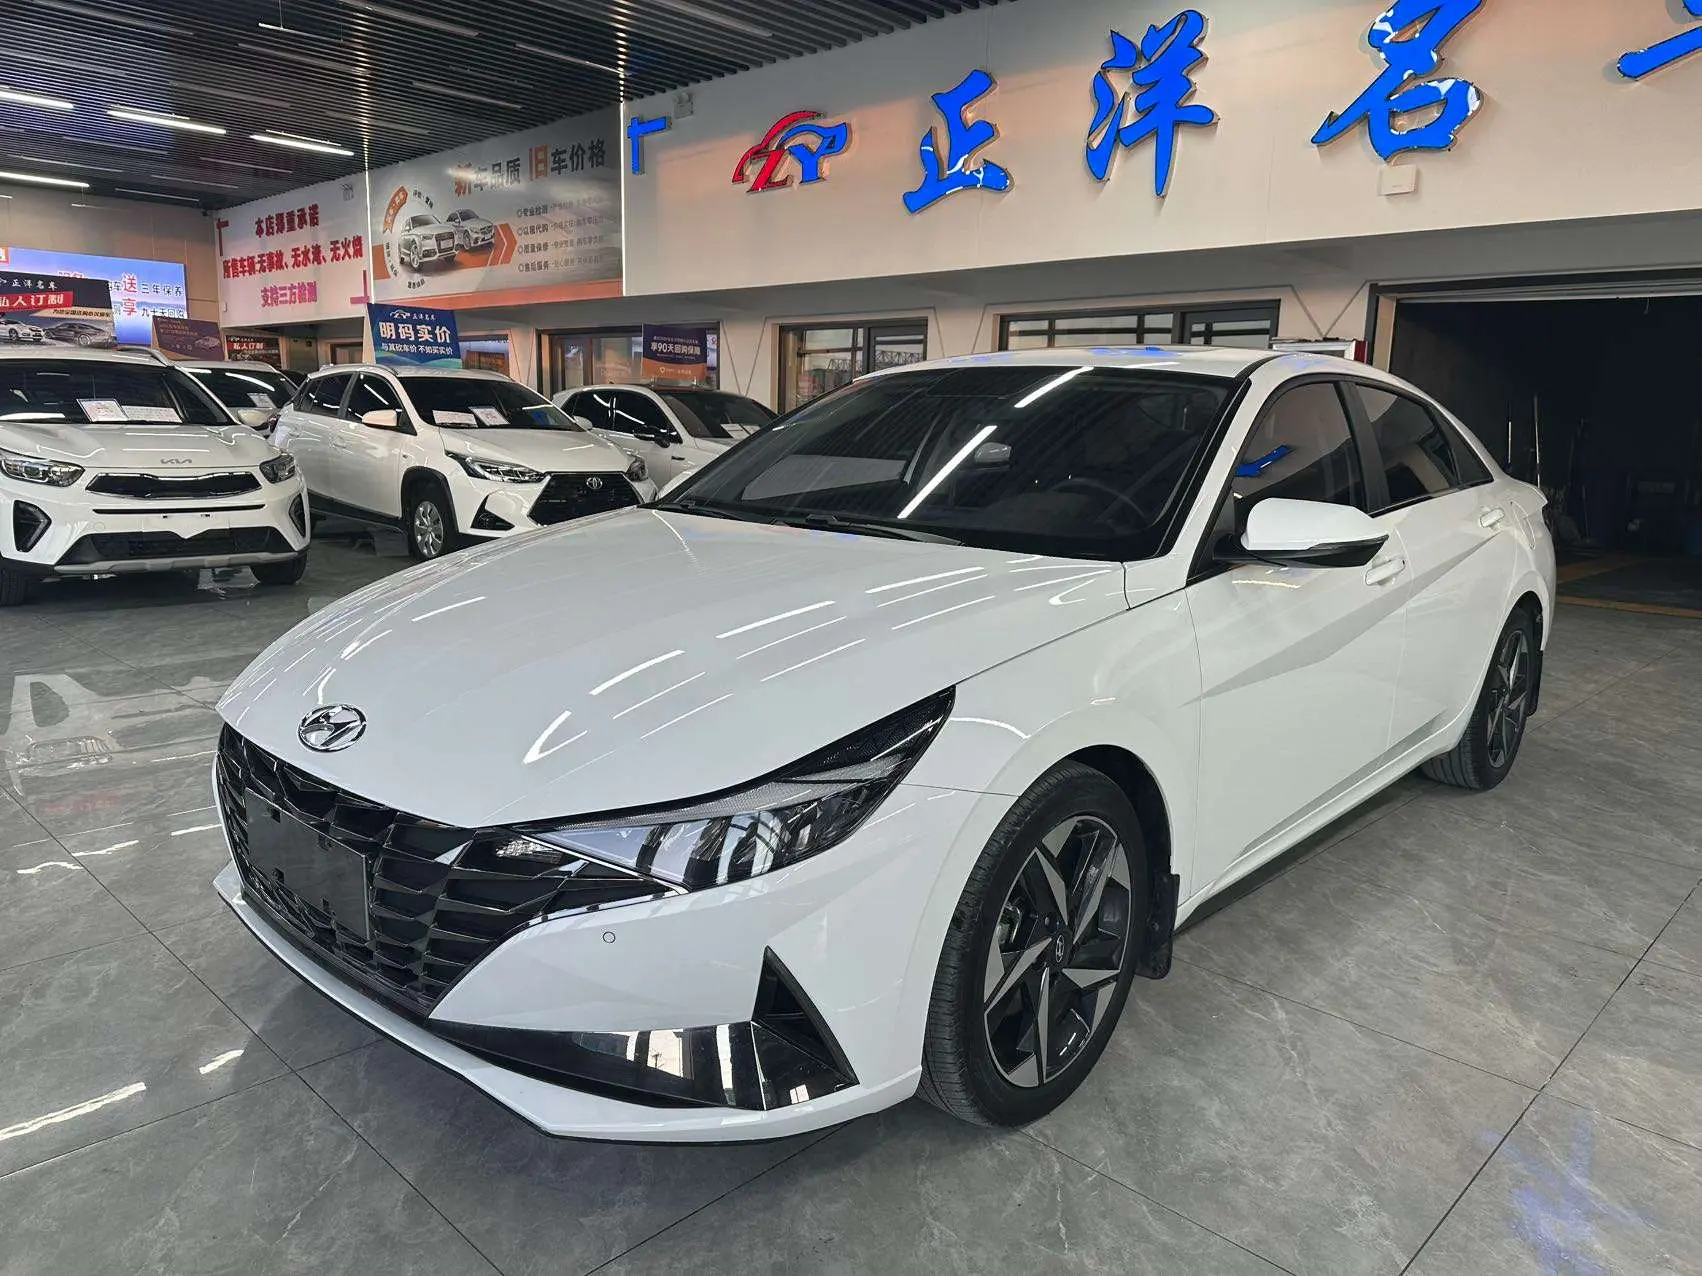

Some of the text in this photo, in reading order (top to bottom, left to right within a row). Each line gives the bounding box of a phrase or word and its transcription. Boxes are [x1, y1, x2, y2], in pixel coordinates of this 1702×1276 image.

[903, 0, 1702, 212] 正洋名
[529, 137, 606, 182] 旧车价格
[261, 281, 318, 308] 支持三方检测
[379, 321, 452, 344] 明码实价
